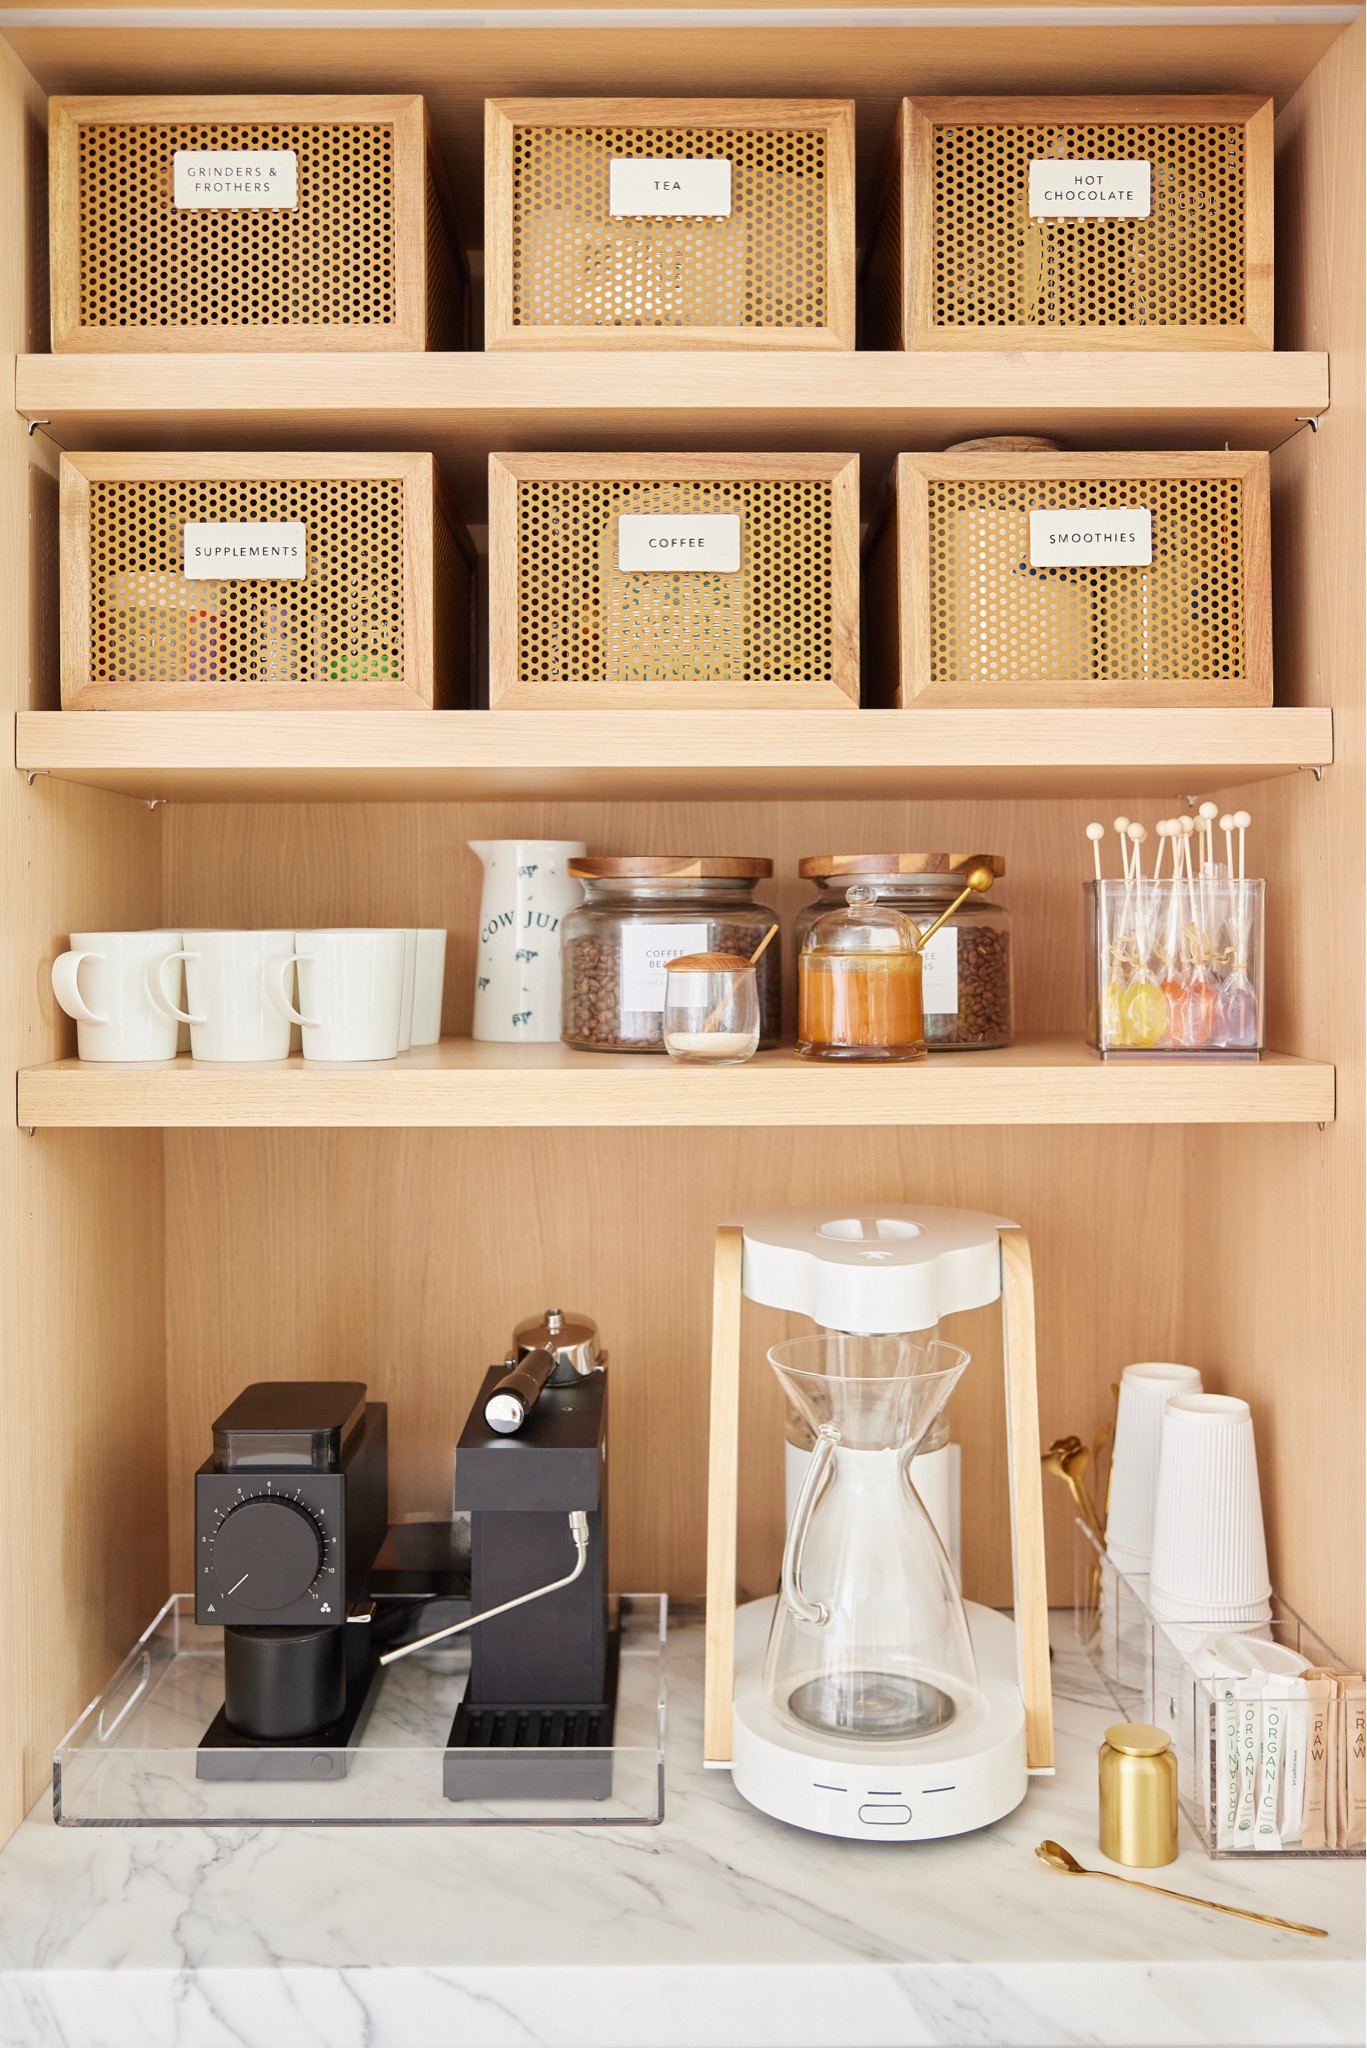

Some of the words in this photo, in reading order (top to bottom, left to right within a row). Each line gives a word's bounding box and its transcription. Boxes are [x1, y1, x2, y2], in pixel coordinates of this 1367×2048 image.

[187, 167, 262, 177] GRINDERS
[268, 167, 278, 177] &
[1074, 175, 1104, 185] HOT
[195, 182, 270, 192] FROTHERS
[654, 181, 681, 191] TEA
[1044, 190, 1134, 201] CHOCOLATE
[648, 538, 705, 548] COFFEE
[1049, 532, 1136, 545] SMOOTHIES
[195, 546, 298, 557] SUPPLEMENTS
[481, 910, 515, 944] COW
[523, 911, 559, 932] JUI
[645, 949, 685, 958] COFFEE
[327, 1566, 335, 1574] 10
[1311, 1720, 1324, 1761] RAW
[1352, 1717, 1366, 1758] RAW
[1244, 1710, 1255, 1804] ORGANIC
[1262, 1713, 1279, 1808] ORGANIC
